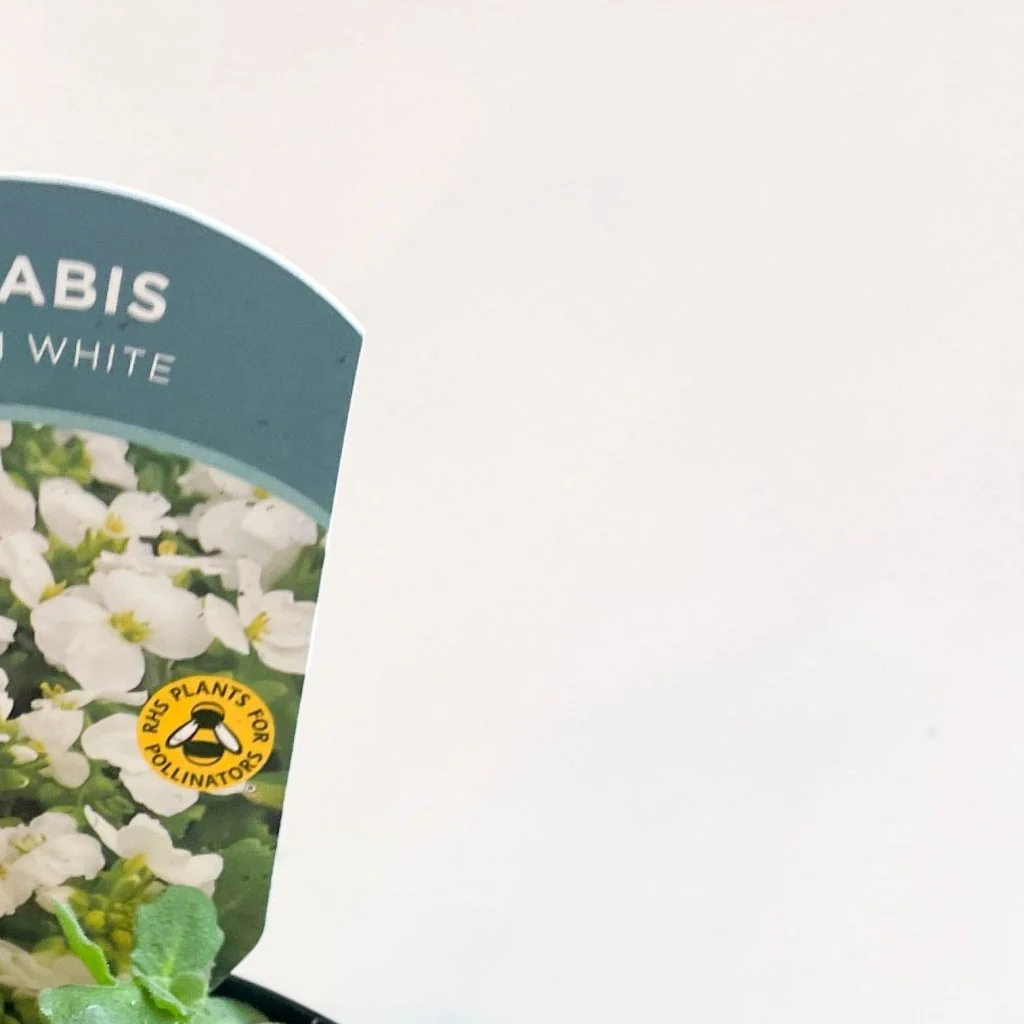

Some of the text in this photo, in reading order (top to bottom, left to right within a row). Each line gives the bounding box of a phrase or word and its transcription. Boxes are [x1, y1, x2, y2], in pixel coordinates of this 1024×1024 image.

[27, 332, 176, 385] WHITE
[142, 680, 270, 744] RHS PLANTS FOR
[144, 742, 264, 788] POLLINATORS
